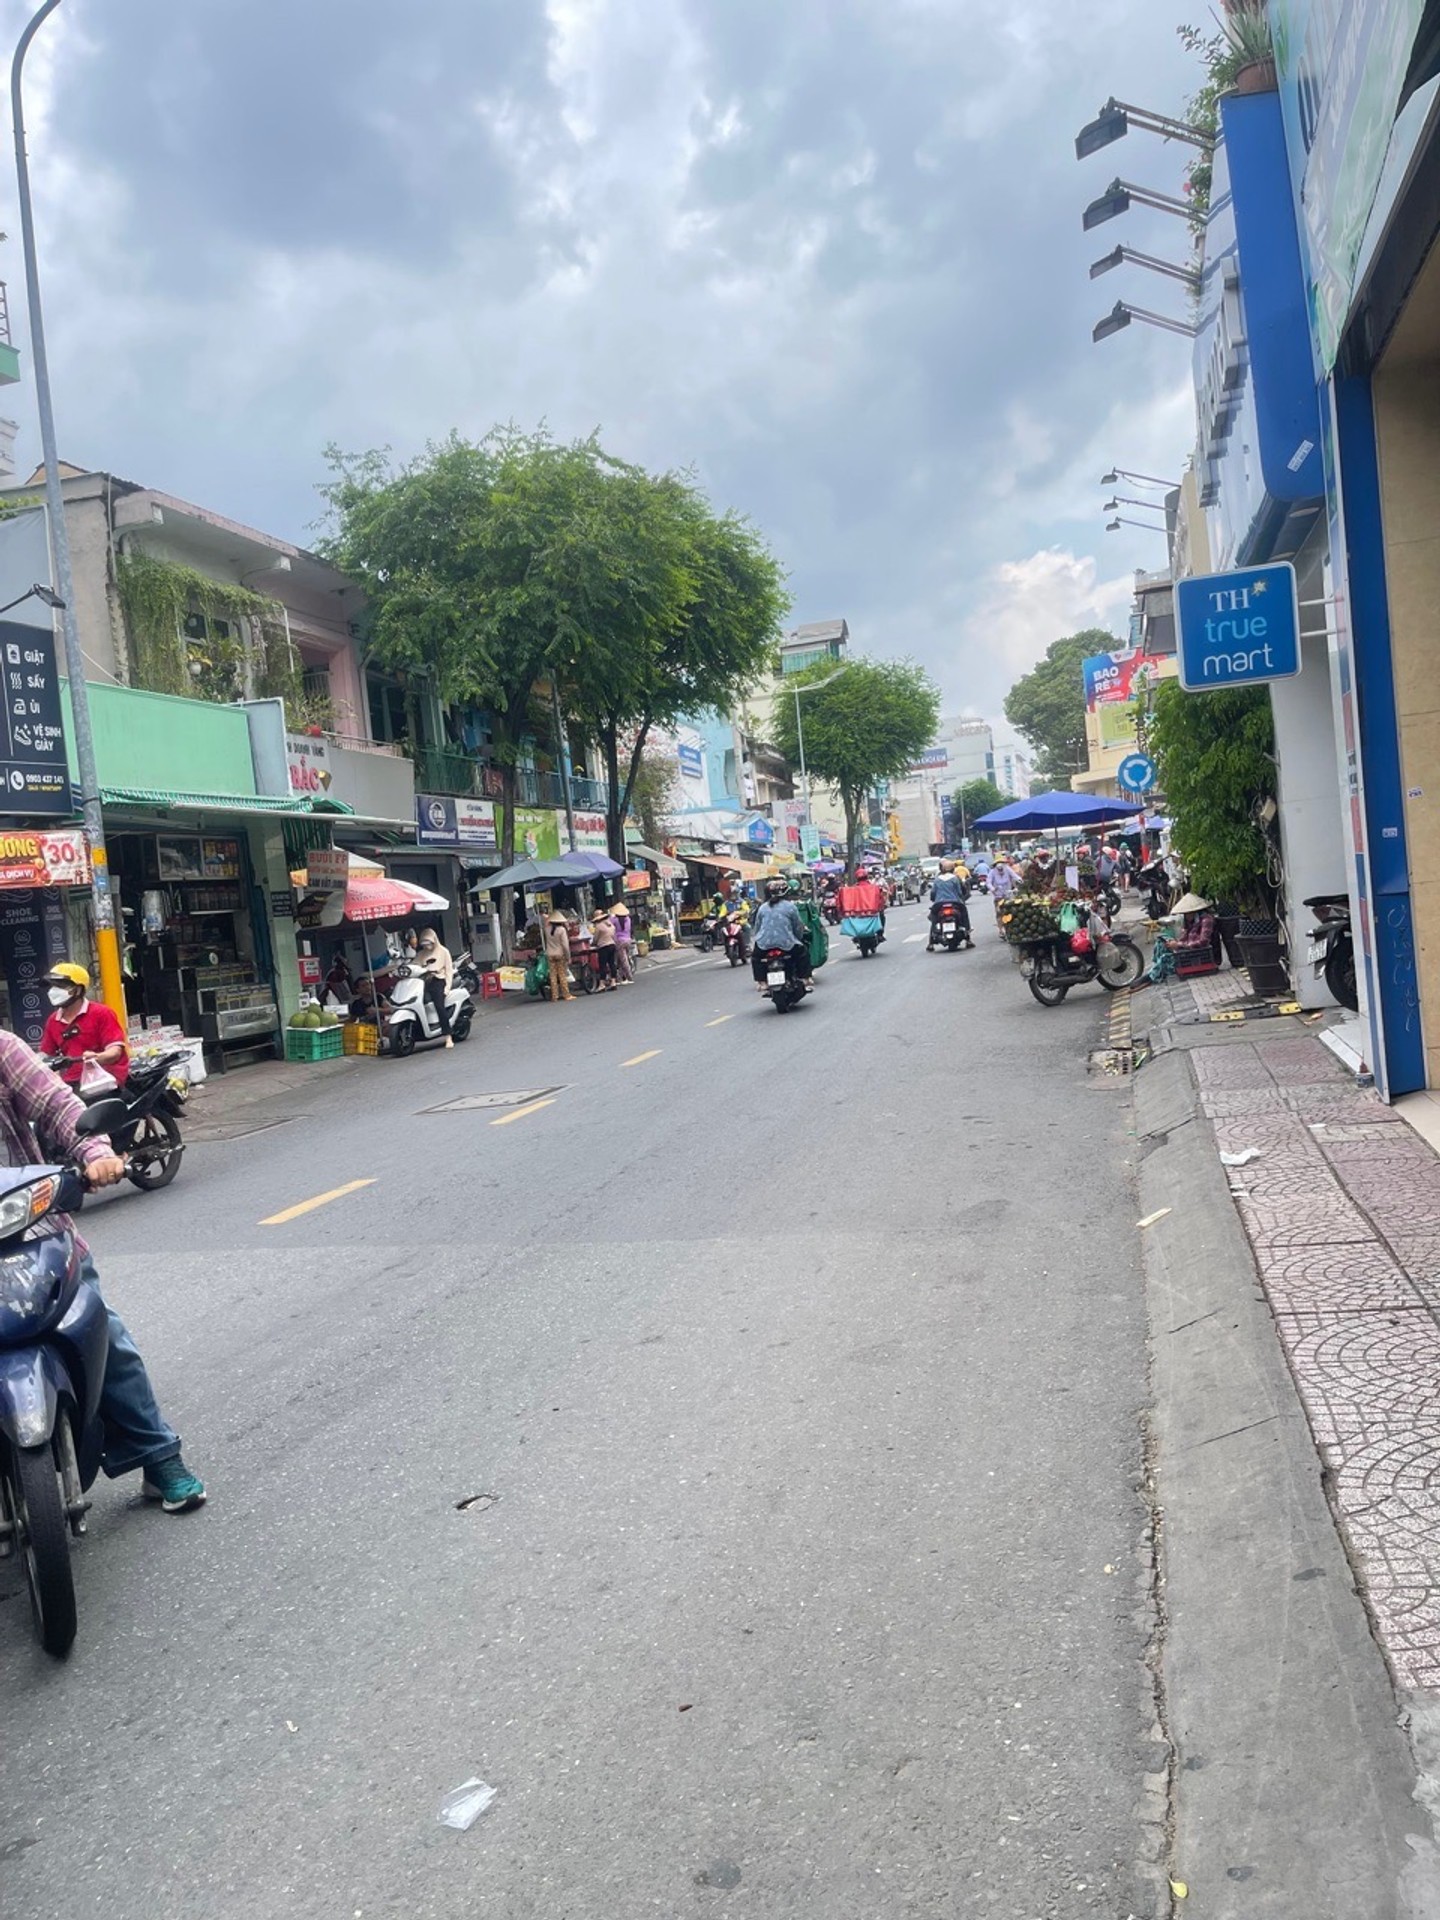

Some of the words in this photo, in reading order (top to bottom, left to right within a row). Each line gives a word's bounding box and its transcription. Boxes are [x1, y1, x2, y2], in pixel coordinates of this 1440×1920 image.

[1209, 587, 1251, 613] TH
[1204, 616, 1268, 642] true
[24, 649, 45, 666] GIẬT
[1203, 642, 1274, 676] mart
[27, 674, 45, 689] SẤY
